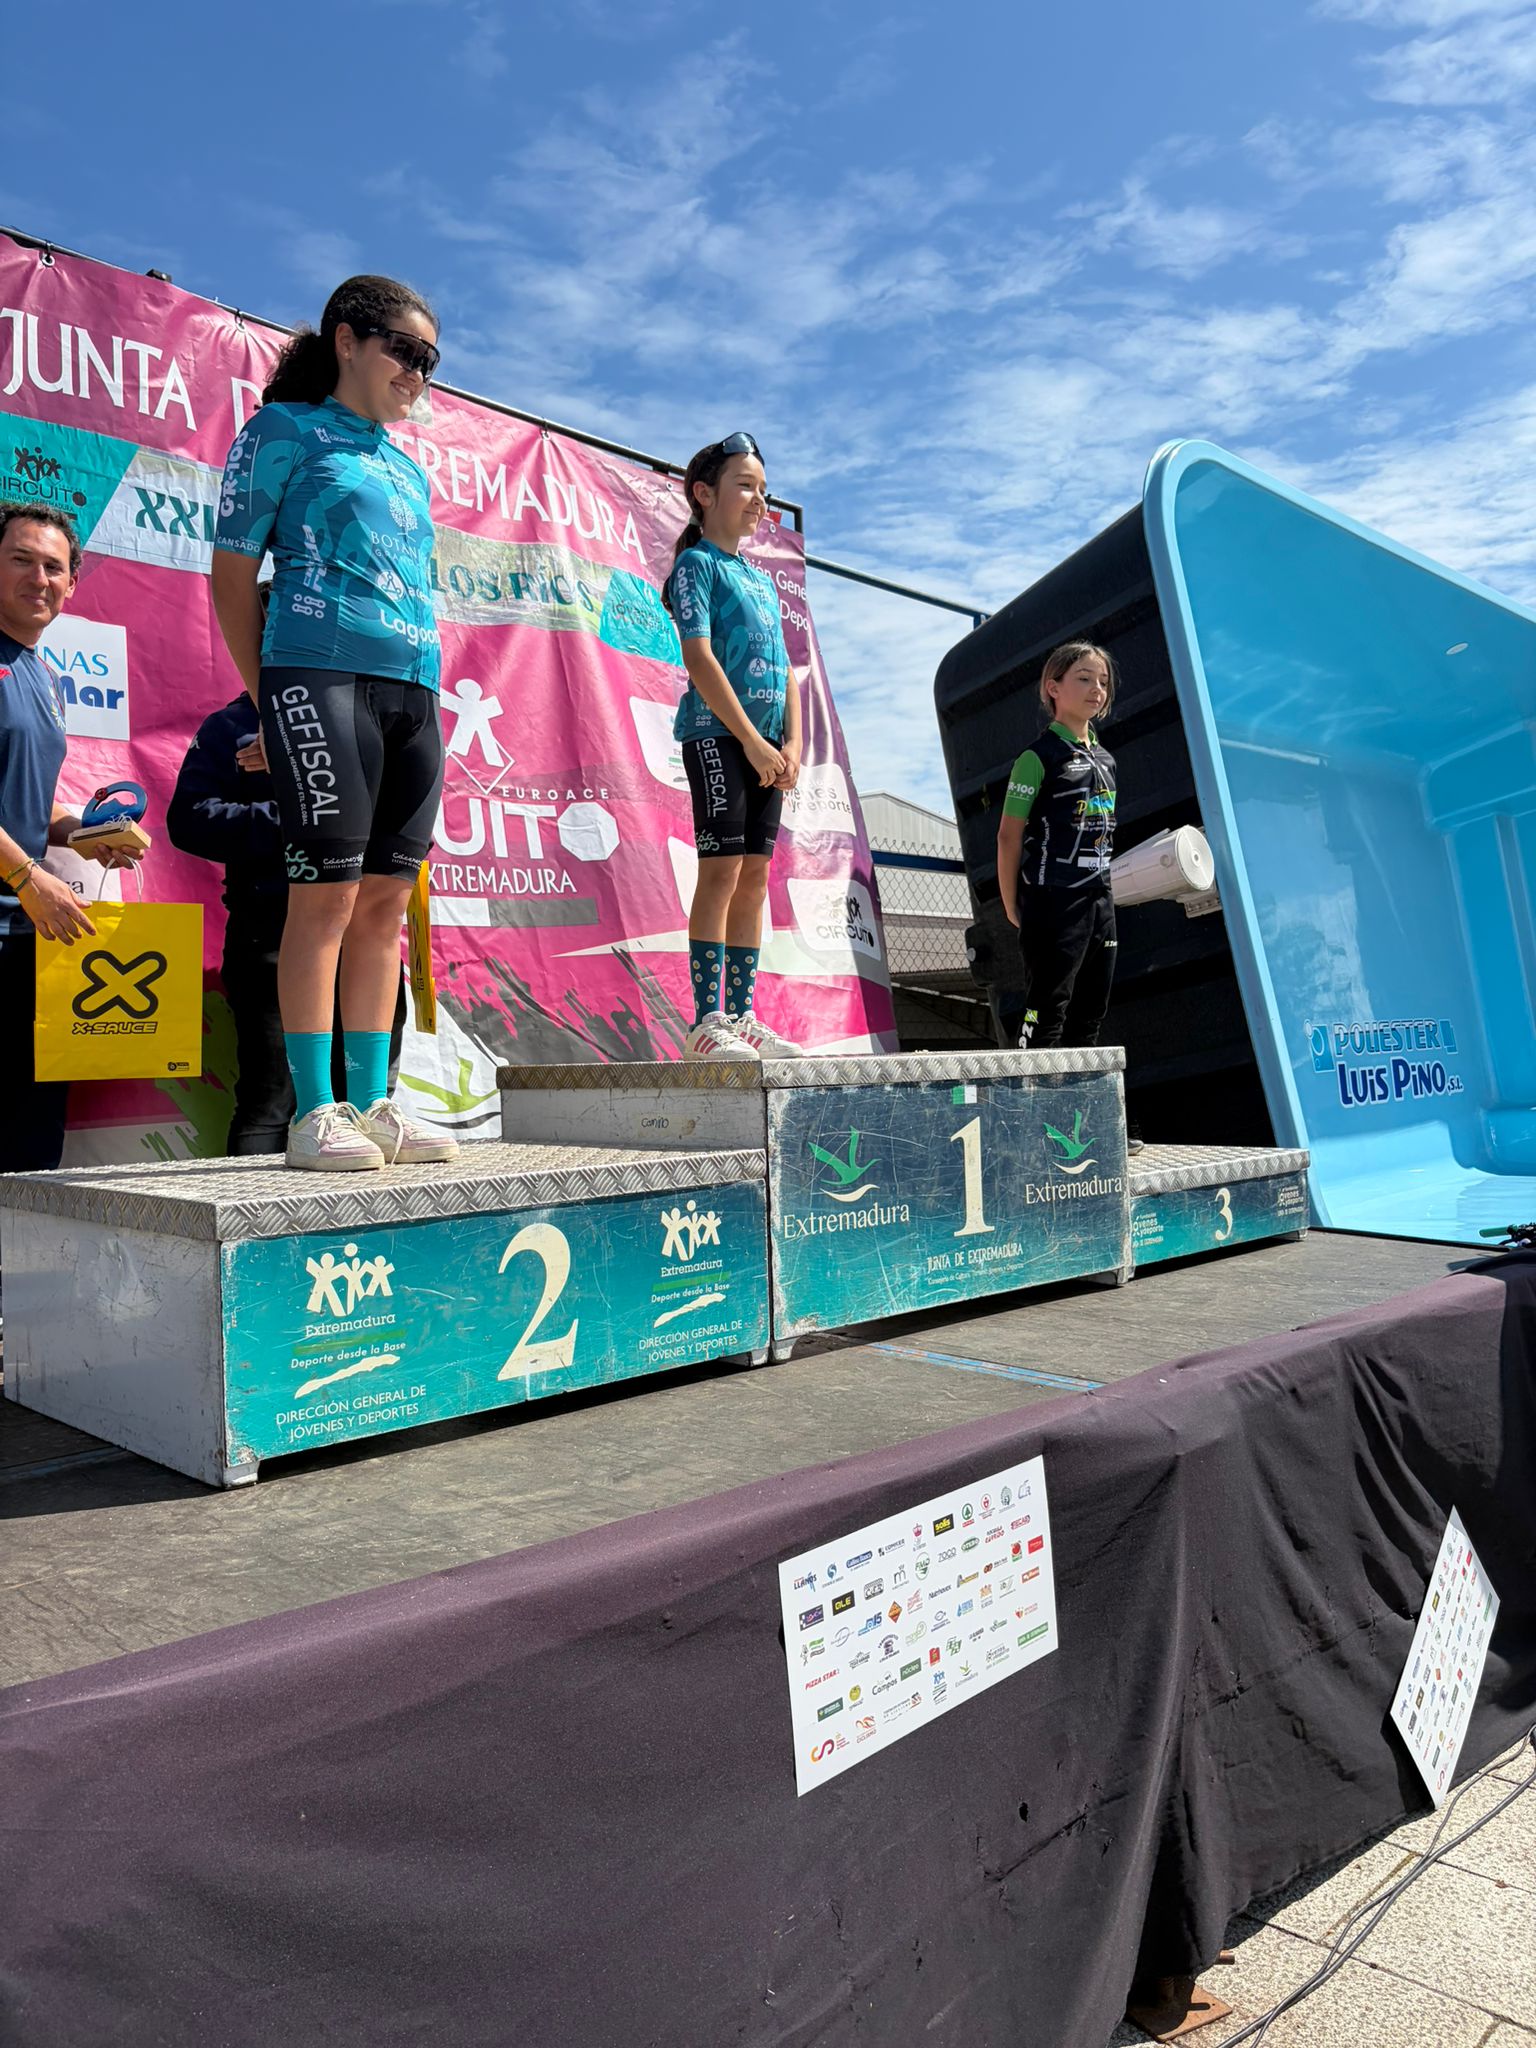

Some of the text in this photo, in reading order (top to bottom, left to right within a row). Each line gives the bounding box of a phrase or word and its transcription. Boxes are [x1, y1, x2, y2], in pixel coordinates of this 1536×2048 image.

[0, 307, 197, 431] JUNTA
[388, 429, 648, 565] TREMADURA
[220, 430, 249, 518] GR-100
[0, 475, 87, 507] IRCUITO
[217, 536, 260, 553] CANSADO
[677, 566, 693, 620] GR-100
[776, 569, 807, 600] Gene
[780, 599, 810, 631] Depo
[276, 712, 292, 757] INTERNATIONAL
[289, 756, 301, 783] MEMBER
[300, 802, 308, 826] GLOBAL
[281, 685, 340, 826] GEFISCAL
[502, 786, 609, 800] EUROACE
[701, 737, 728, 818] GEFISCAL
[1008, 781, 1035, 796] R-100
[433, 798, 621, 862] UITO
[428, 863, 577, 894] XTREMADURA
[72, 1021, 158, 1035] X-SAUCE
[1333, 1019, 1441, 1056] POLIESTER
[950, 1115, 995, 1238] 1
[1025, 1173, 1122, 1205] Extremadura
[783, 1203, 910, 1240] Extremadura
[1214, 1187, 1233, 1241] 3
[661, 1258, 722, 1278] Extremadura
[954, 1251, 965, 1267] DE
[968, 1242, 1024, 1265] EXTREMADURA
[497, 1222, 579, 1381] 2
[651, 1282, 731, 1304] Deporte desde la Base
[304, 1313, 396, 1338] Extremadura
[638, 1319, 742, 1350] DIRECCIÓN GENERAL DE
[291, 1341, 407, 1369] Deporte desde la Base
[648, 1334, 738, 1364] JÓVENES Y DEPORTES
[275, 1384, 427, 1426] DIRECCIÓN GENERAL DE
[289, 1402, 419, 1444] JÓVENES Y DEPORTES
[805, 1669, 837, 1690] PIZZA STAR
[872, 1678, 898, 1696] Campos
